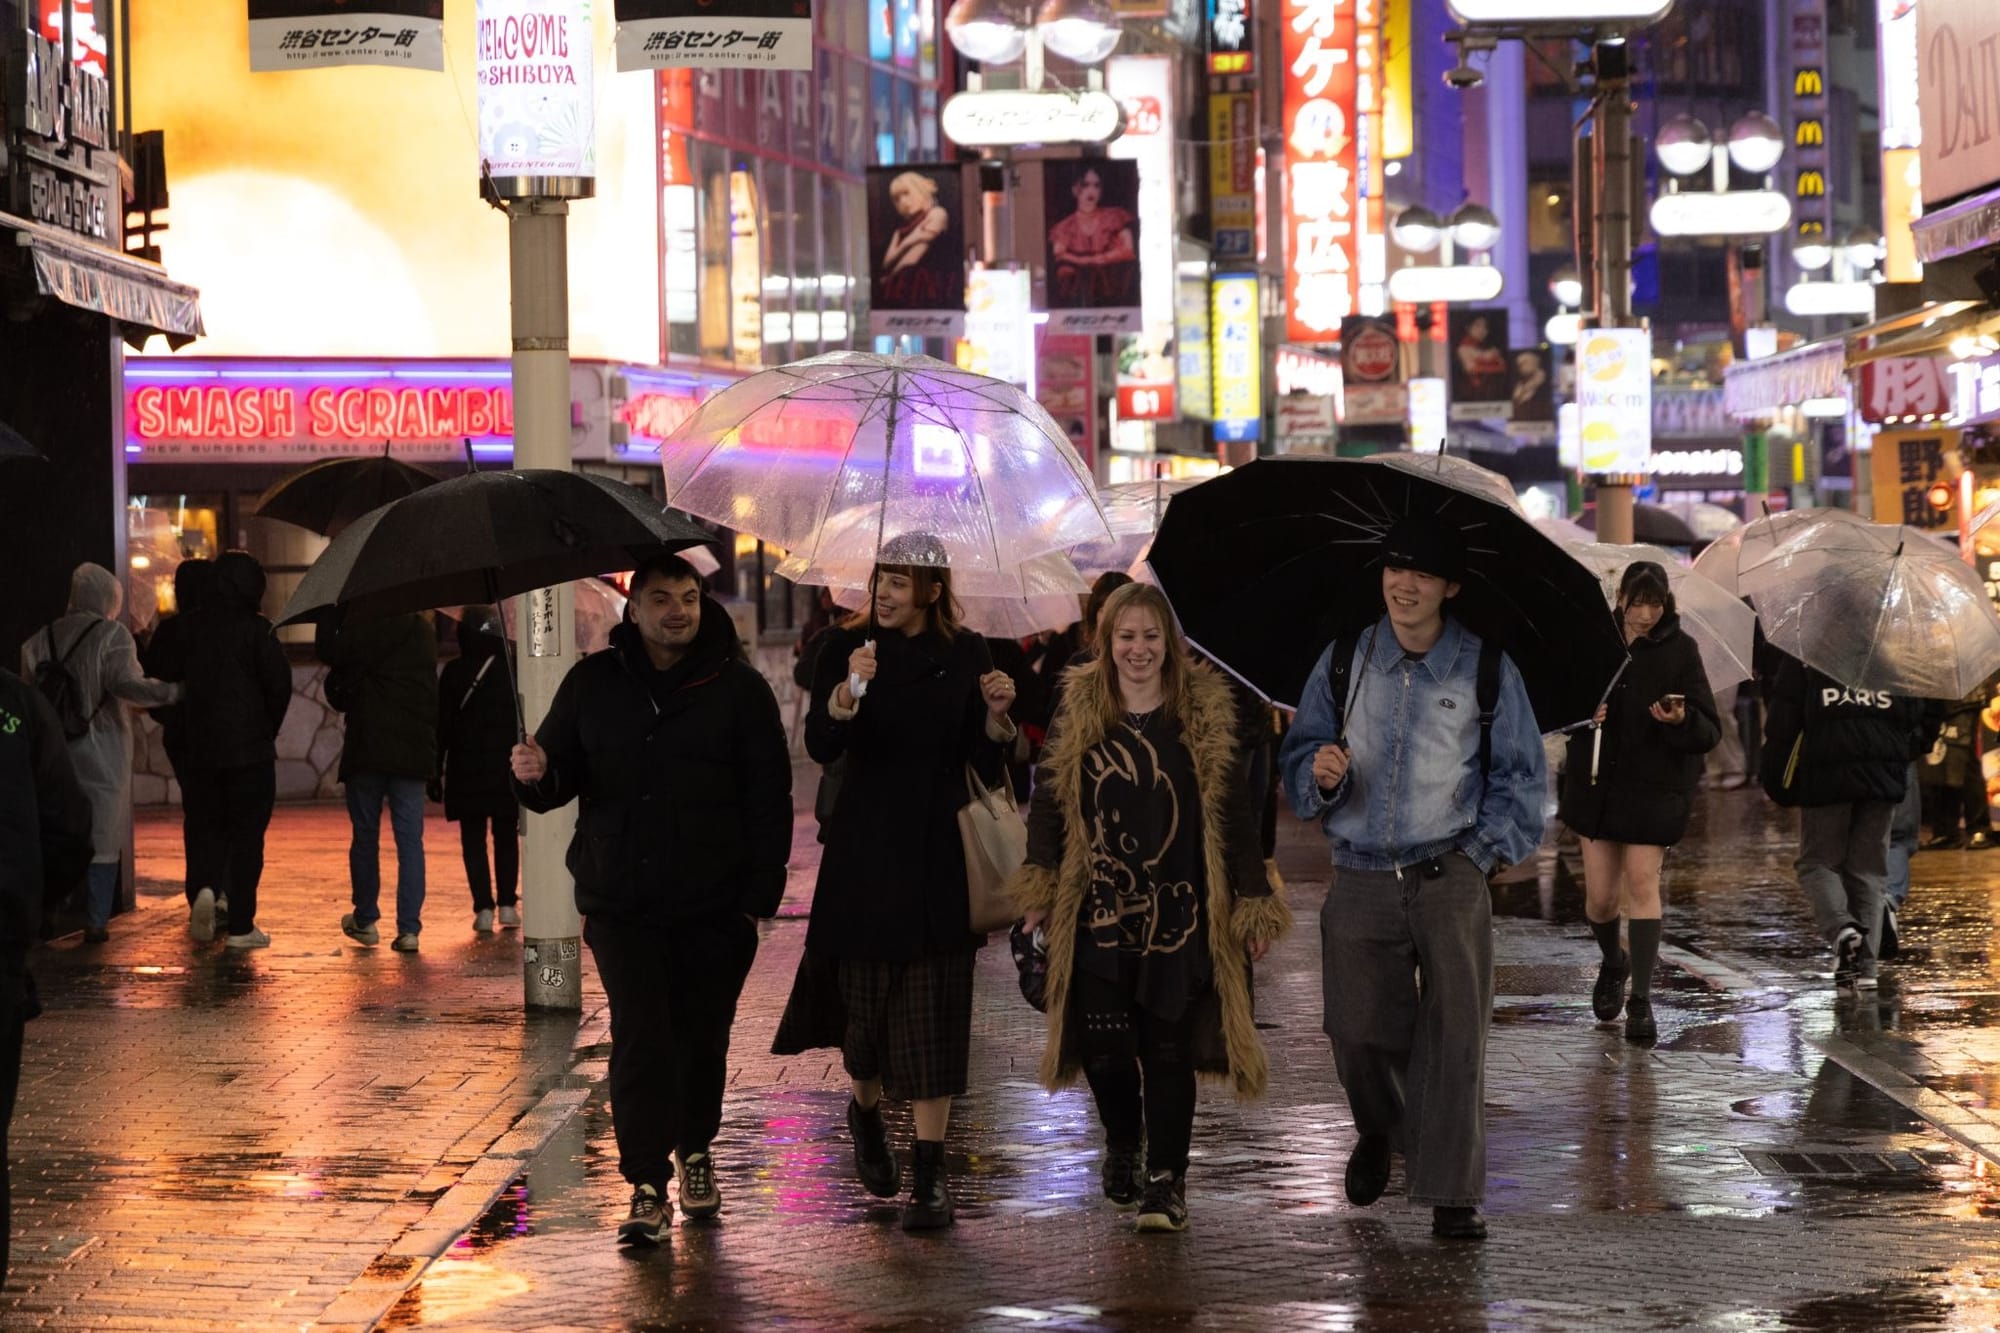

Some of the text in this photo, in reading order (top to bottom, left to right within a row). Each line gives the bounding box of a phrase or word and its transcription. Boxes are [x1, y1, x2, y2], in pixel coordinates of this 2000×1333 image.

[279, 27, 418, 49] 渋谷センター街
[643, 30, 783, 50] 渋谷センター街
[489, 64, 577, 86] SHIBUYA
[138, 386, 296, 439] SMASH
[1822, 687, 1893, 709] PARIS
